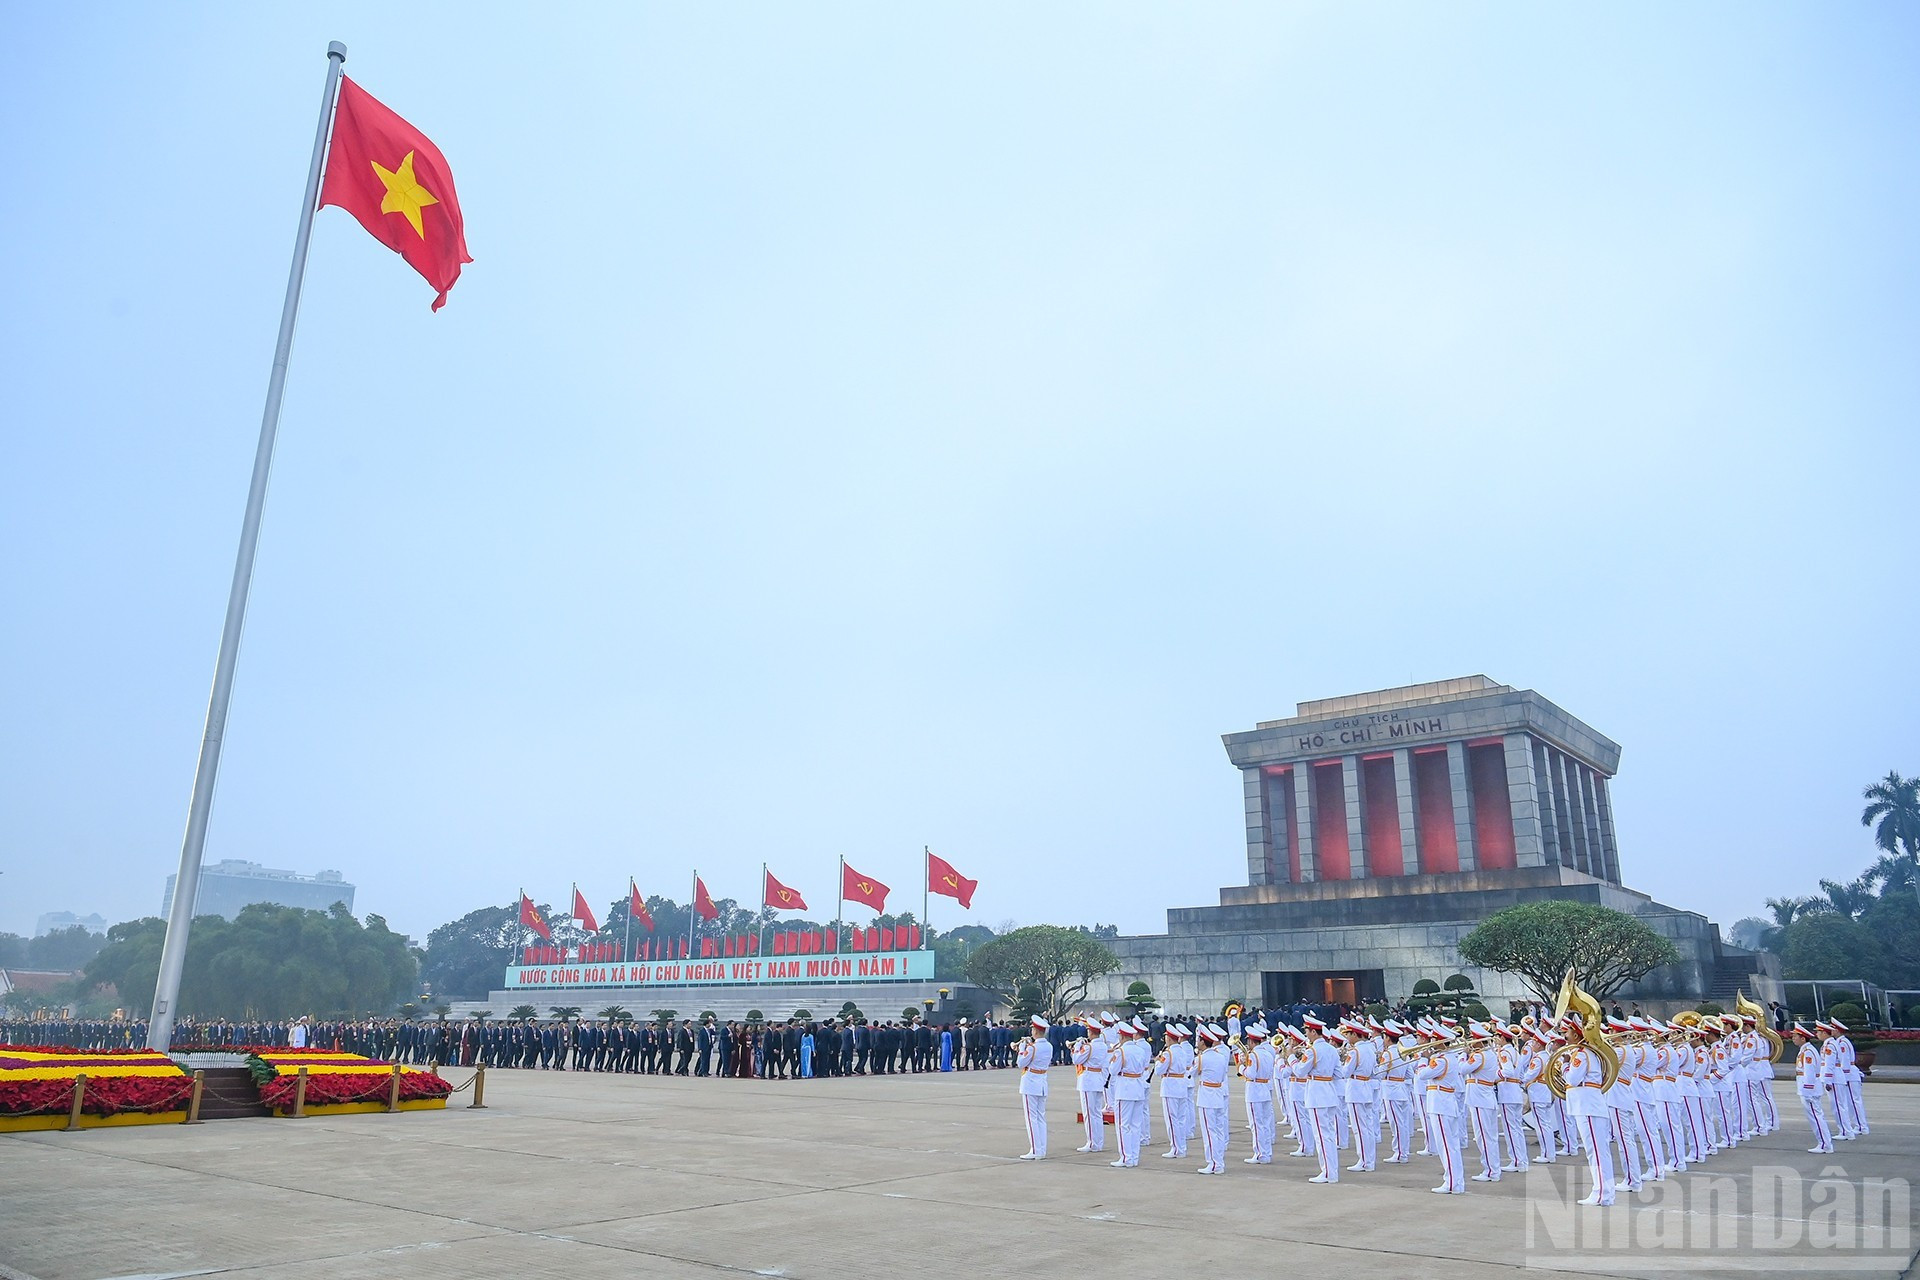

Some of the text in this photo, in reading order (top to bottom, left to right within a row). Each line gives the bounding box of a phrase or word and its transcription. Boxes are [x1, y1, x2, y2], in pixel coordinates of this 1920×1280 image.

[520, 967, 546, 984] NƯỚC
[551, 966, 580, 986] CỘNG
[584, 966, 606, 982] HÒA
[611, 965, 626, 982] XÃ
[630, 964, 650, 984] HỘI
[656, 961, 680, 981] CHỦ
[686, 962, 726, 980] NGHĨA
[732, 960, 762, 982] VIỆT
[768, 962, 800, 978] NAM
[806, 956, 852, 977] MUÔN
[858, 954, 895, 976] NĂM
